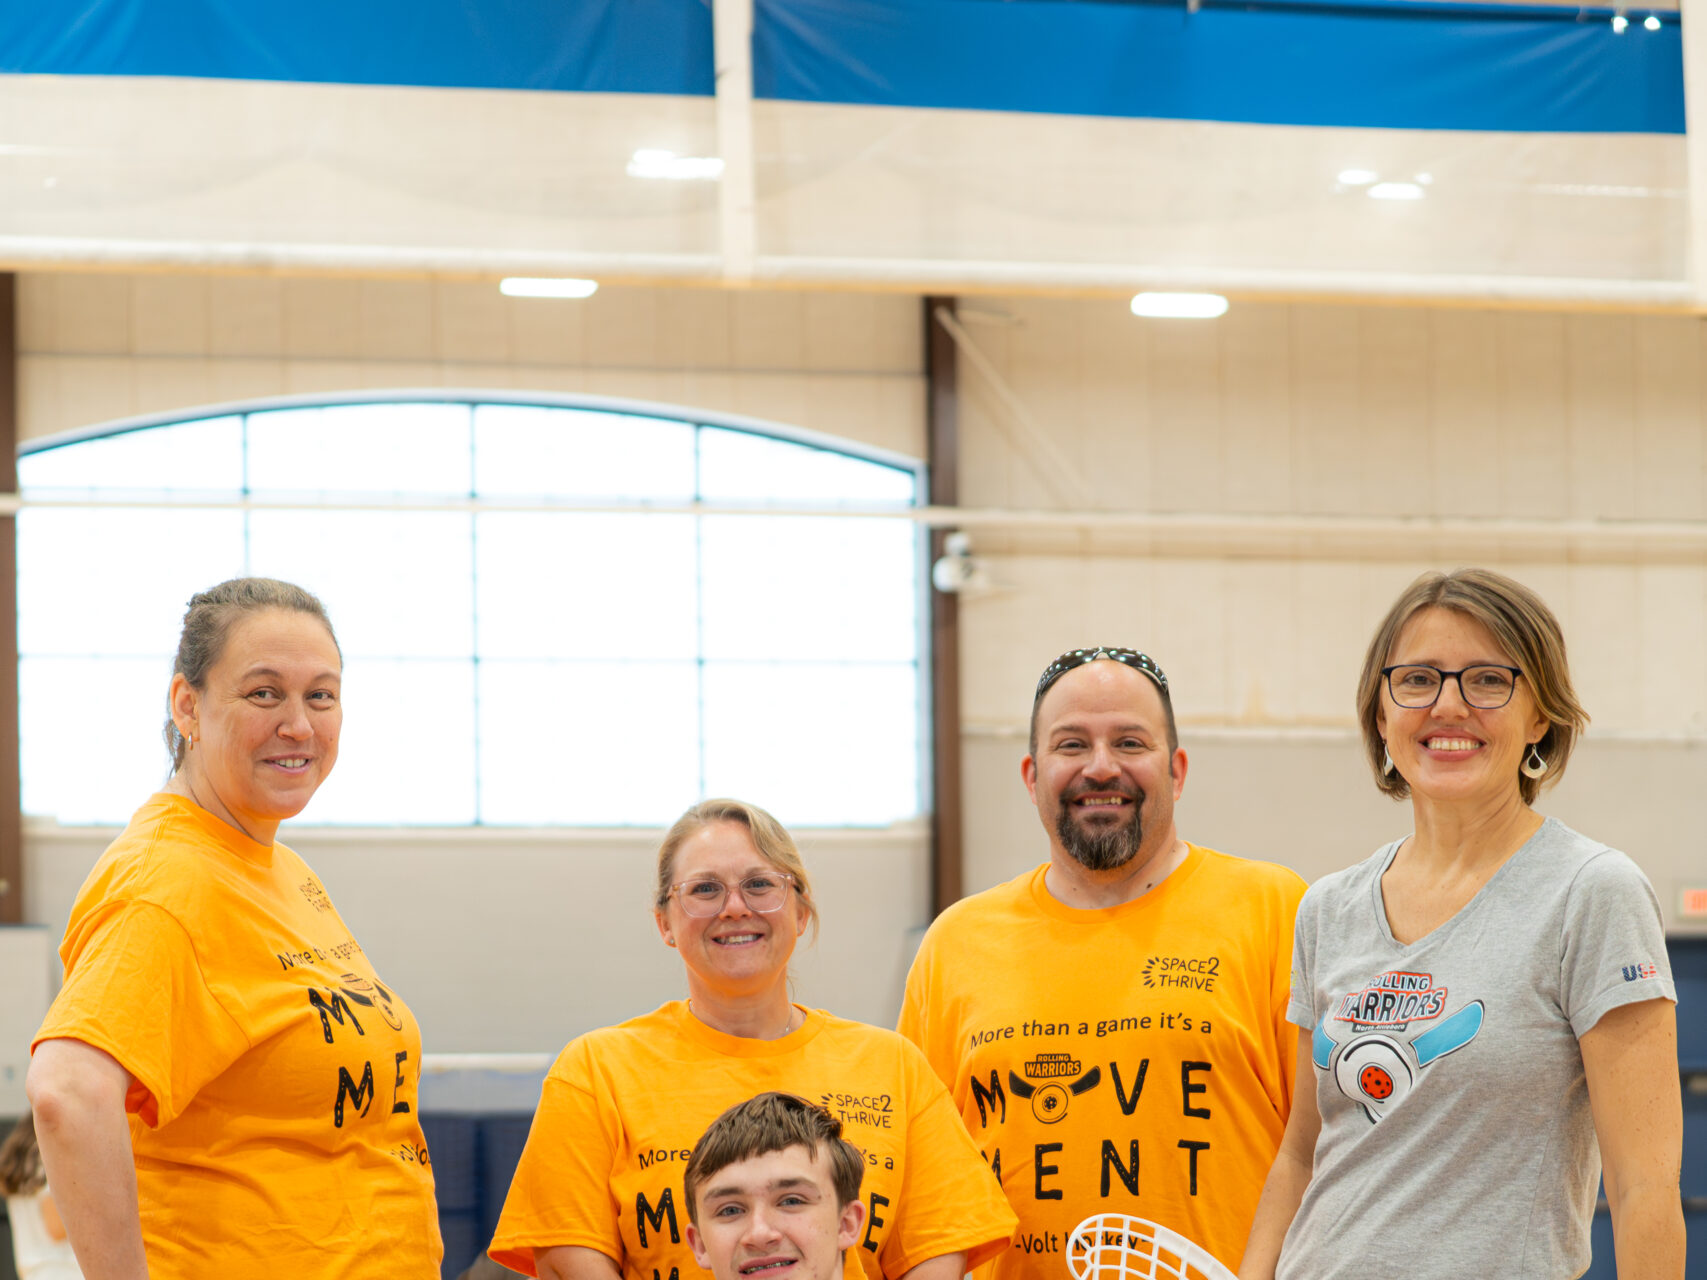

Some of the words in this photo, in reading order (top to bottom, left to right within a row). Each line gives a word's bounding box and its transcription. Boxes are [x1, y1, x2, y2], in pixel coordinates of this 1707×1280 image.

[1160, 956, 1220, 977] SPACE2
[1158, 974, 1216, 993] THRIVE
[969, 1025, 1015, 1049] More
[1022, 1018, 1070, 1037] than
[1077, 1021, 1089, 1035] a
[1095, 1015, 1152, 1038] game
[1160, 1012, 1193, 1031] it's
[1200, 1020, 1212, 1034] a
[1037, 1054, 1070, 1062] ROLLING
[1026, 1061, 1081, 1077] WARRIORS
[836, 1093, 894, 1113] SPACE2
[837, 1109, 892, 1129] THRIVE
[638, 1147, 691, 1171] More
[884, 1156, 894, 1170] a
